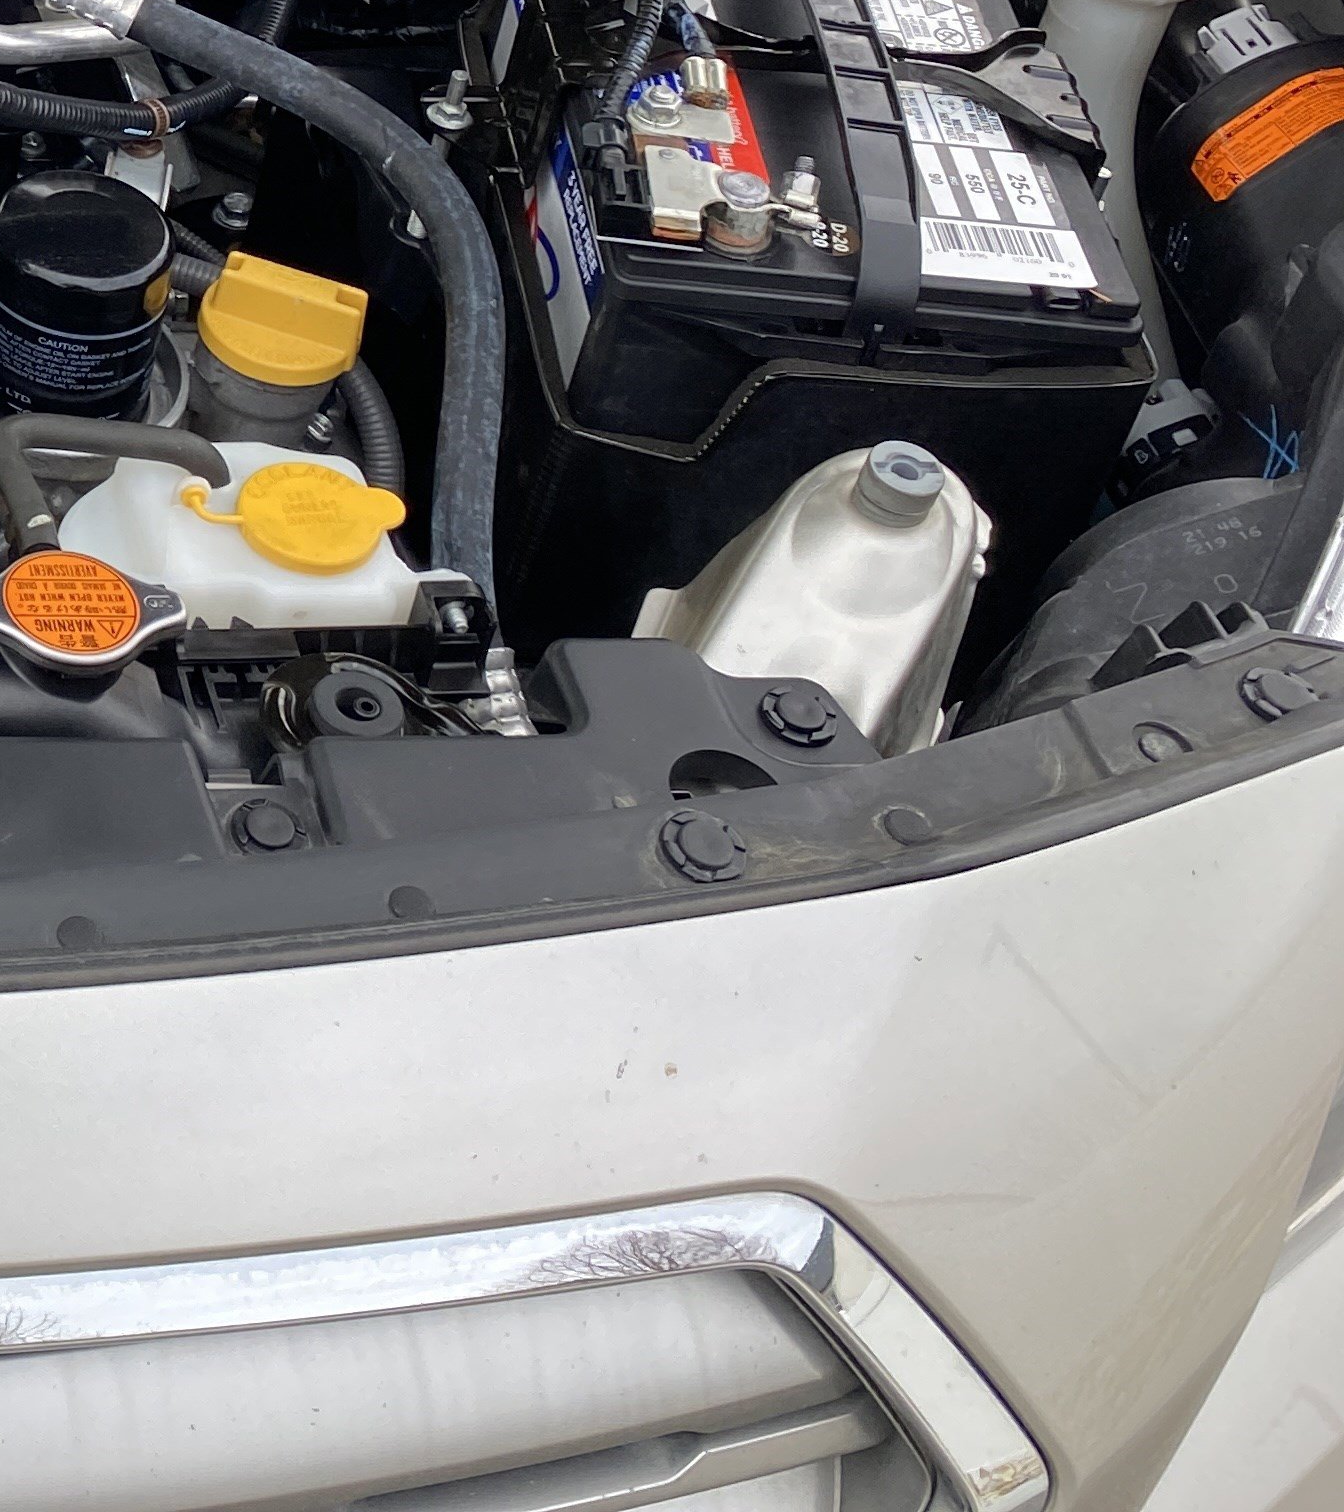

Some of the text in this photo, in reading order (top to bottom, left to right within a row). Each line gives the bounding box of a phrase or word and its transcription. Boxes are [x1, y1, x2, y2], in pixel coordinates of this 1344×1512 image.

[962, 15, 986, 50] DANG
[928, 173, 944, 186] 90
[965, 174, 985, 194] 550
[1007, 172, 1037, 206] 25-C
[562, 188, 593, 285] REPLACEMENT
[569, 184, 587, 230] YEAR
[581, 229, 599, 275] FREE
[830, 223, 850, 251] D-20
[38, 336, 89, 353] CAUTION
[38, 593, 65, 602] WHEN
[69, 593, 92, 602] OPEN
[95, 593, 124, 602] NEVER
[34, 618, 96, 633] WARNING
